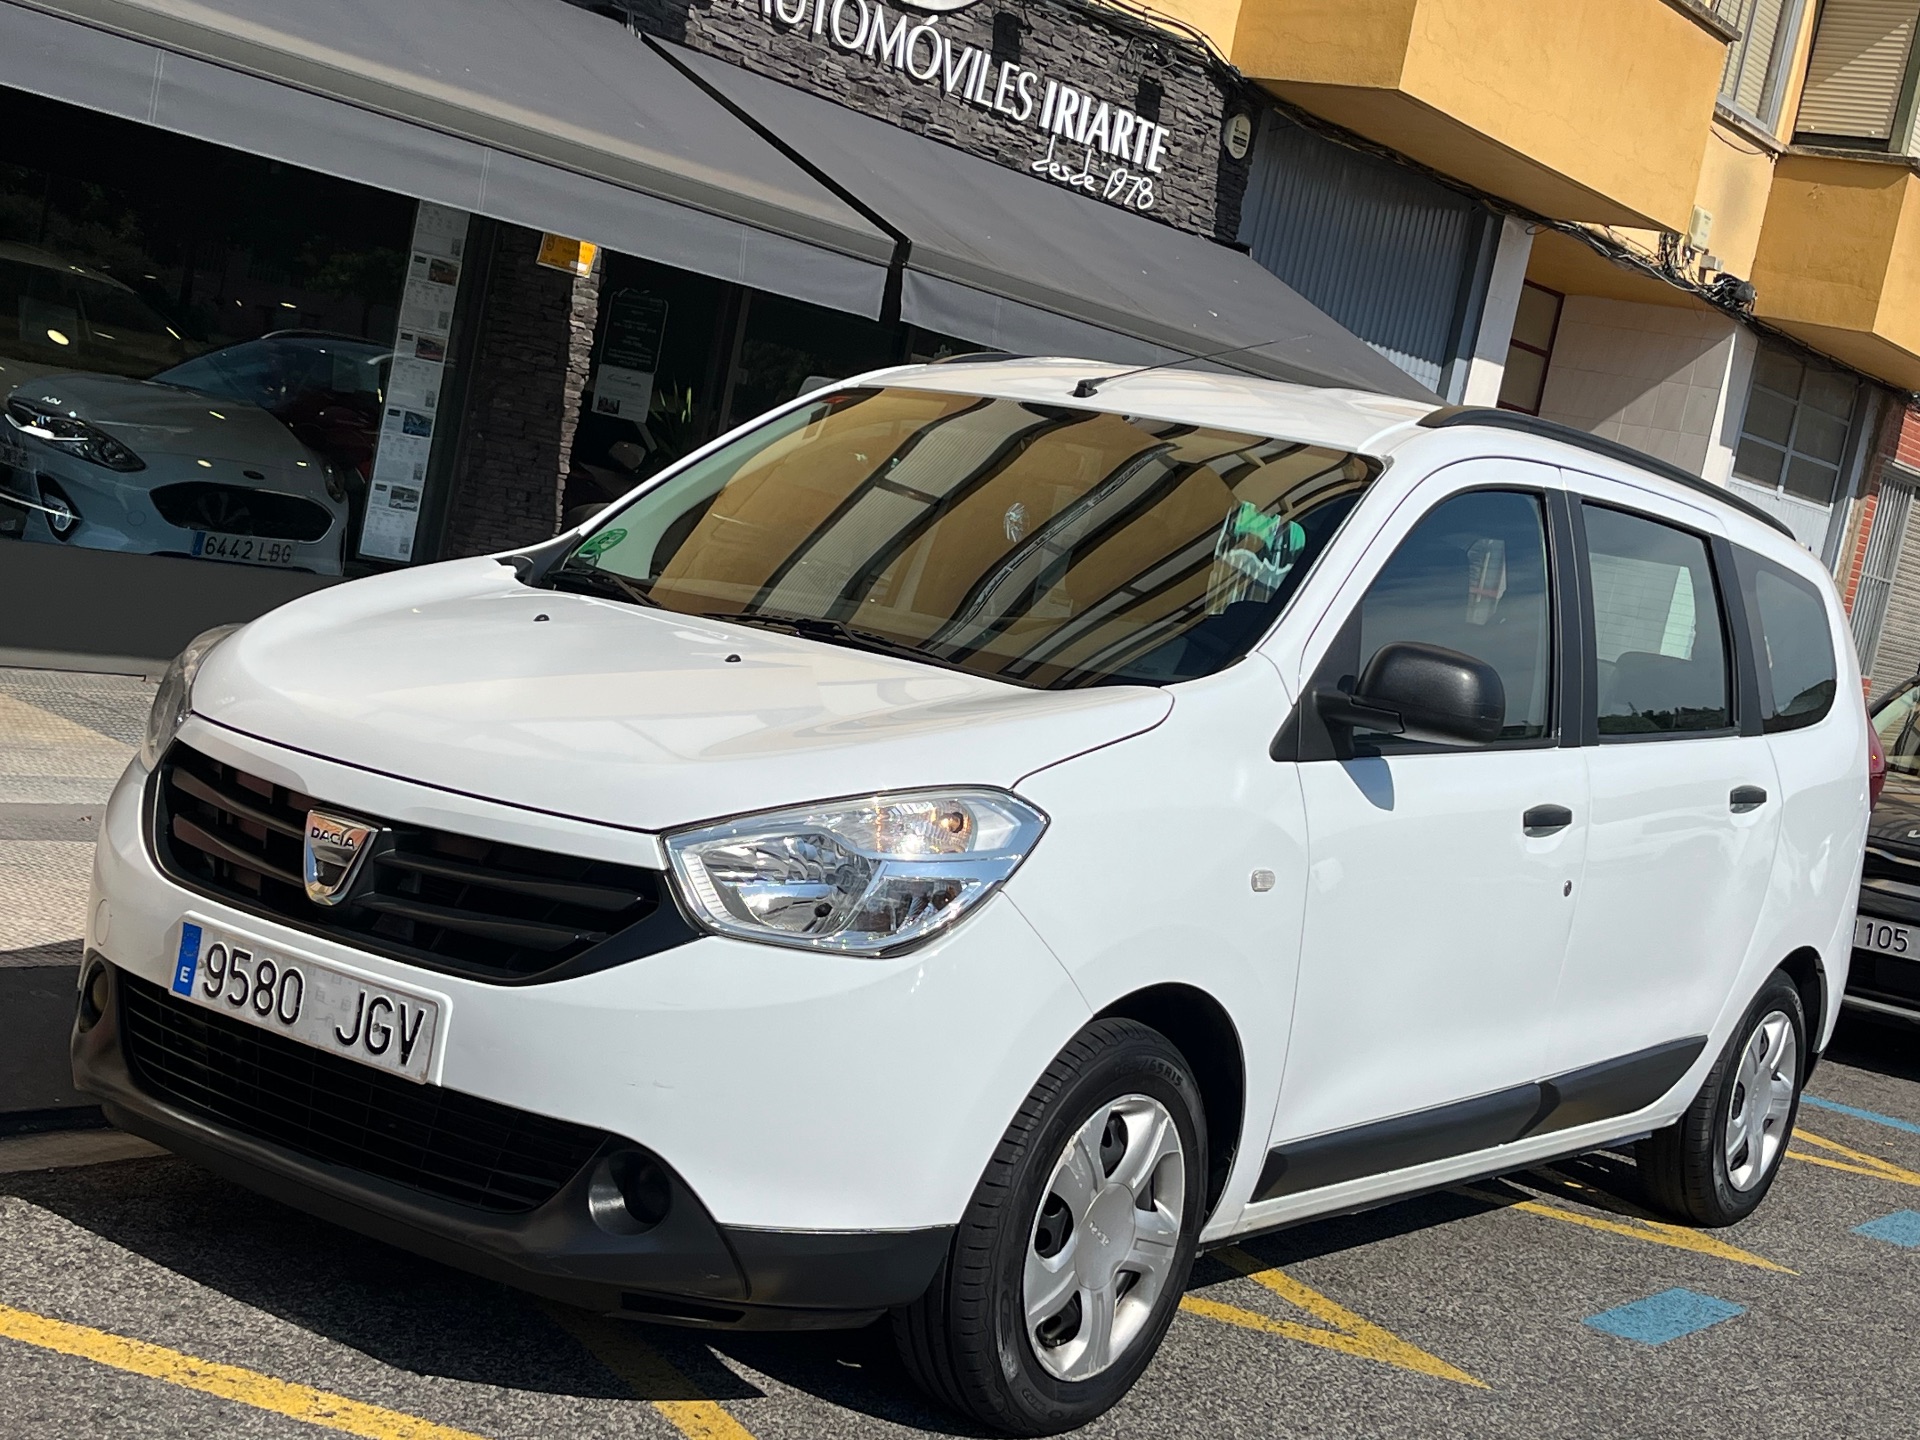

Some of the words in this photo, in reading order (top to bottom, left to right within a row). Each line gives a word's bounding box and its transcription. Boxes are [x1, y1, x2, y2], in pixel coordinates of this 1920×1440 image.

[740, 0, 1037, 121] TOMÓVILES
[1039, 81, 1169, 173] IRIARTE
[1032, 138, 1096, 191] desde
[1102, 169, 1155, 210] 1978
[205, 536, 254, 560] 6442
[310, 826, 356, 850] DACIA
[1853, 919, 1908, 952] 105
[179, 966, 191, 983] E
[203, 943, 303, 1025] 9580
[336, 990, 425, 1066] JGV
